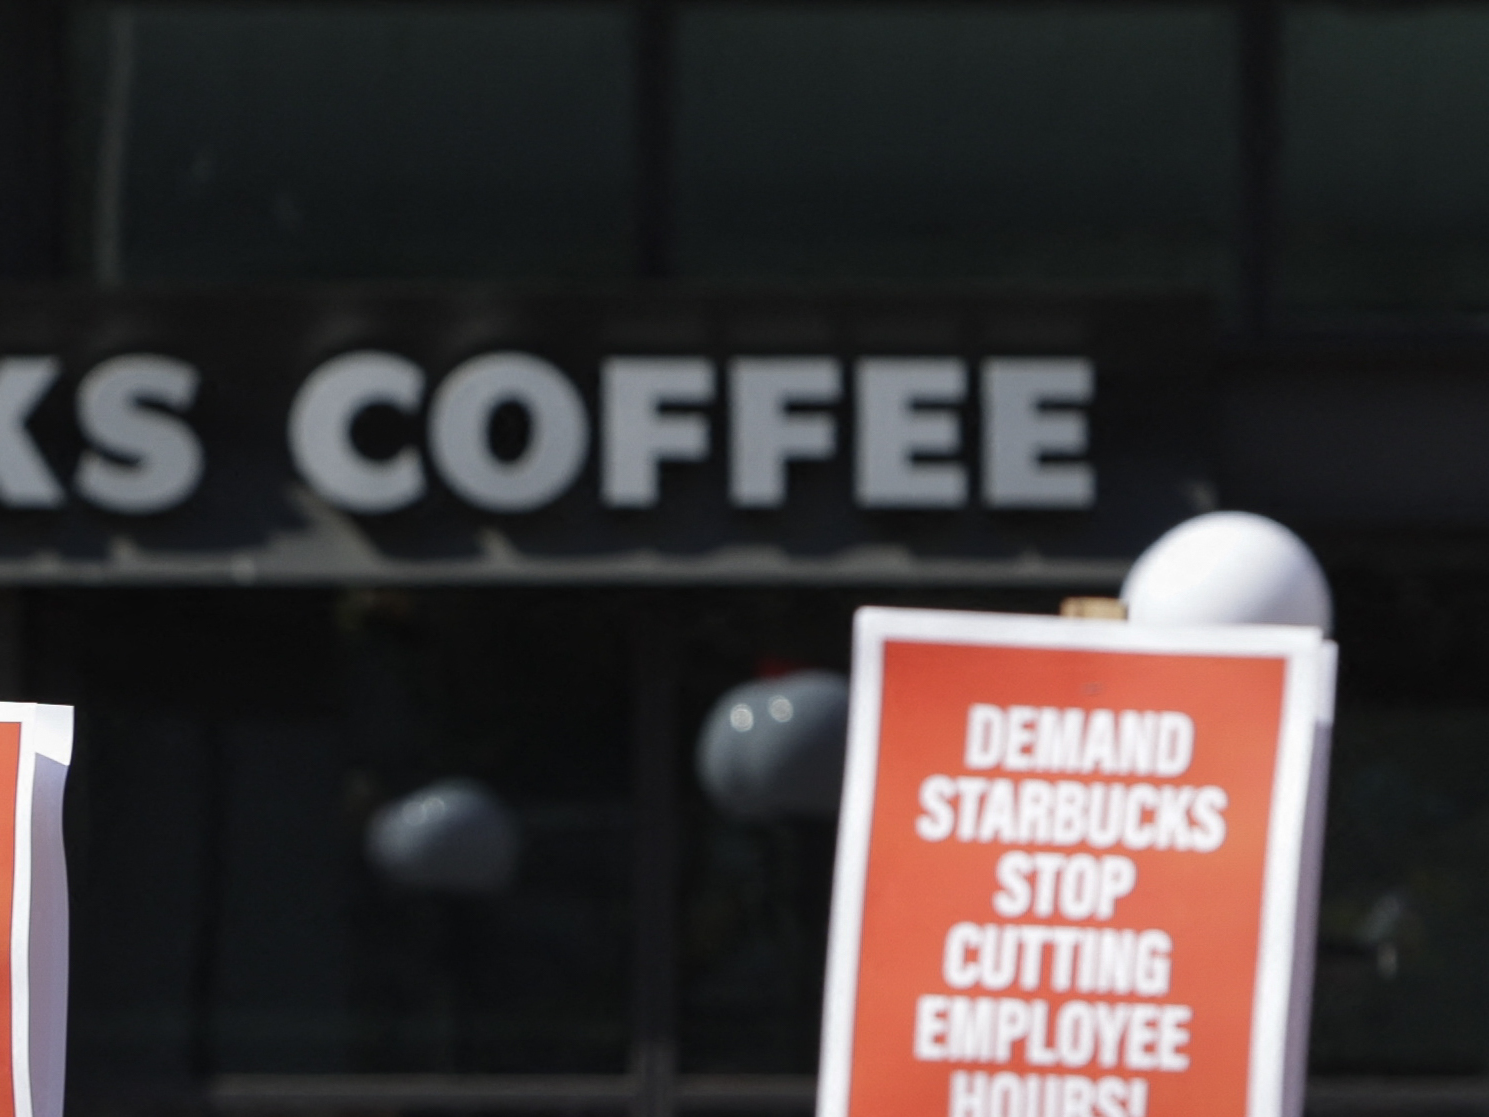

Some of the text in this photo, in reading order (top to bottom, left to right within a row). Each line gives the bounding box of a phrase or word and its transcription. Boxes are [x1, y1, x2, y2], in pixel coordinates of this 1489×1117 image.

[290, 352, 1094, 512] COFFEE
[965, 704, 1195, 775] DEMAND
[915, 775, 1228, 853] STARBUCKS
[993, 852, 1135, 920] STOP
[943, 923, 1171, 997] CUTTING
[914, 995, 1191, 1073] EMPLOYEE
